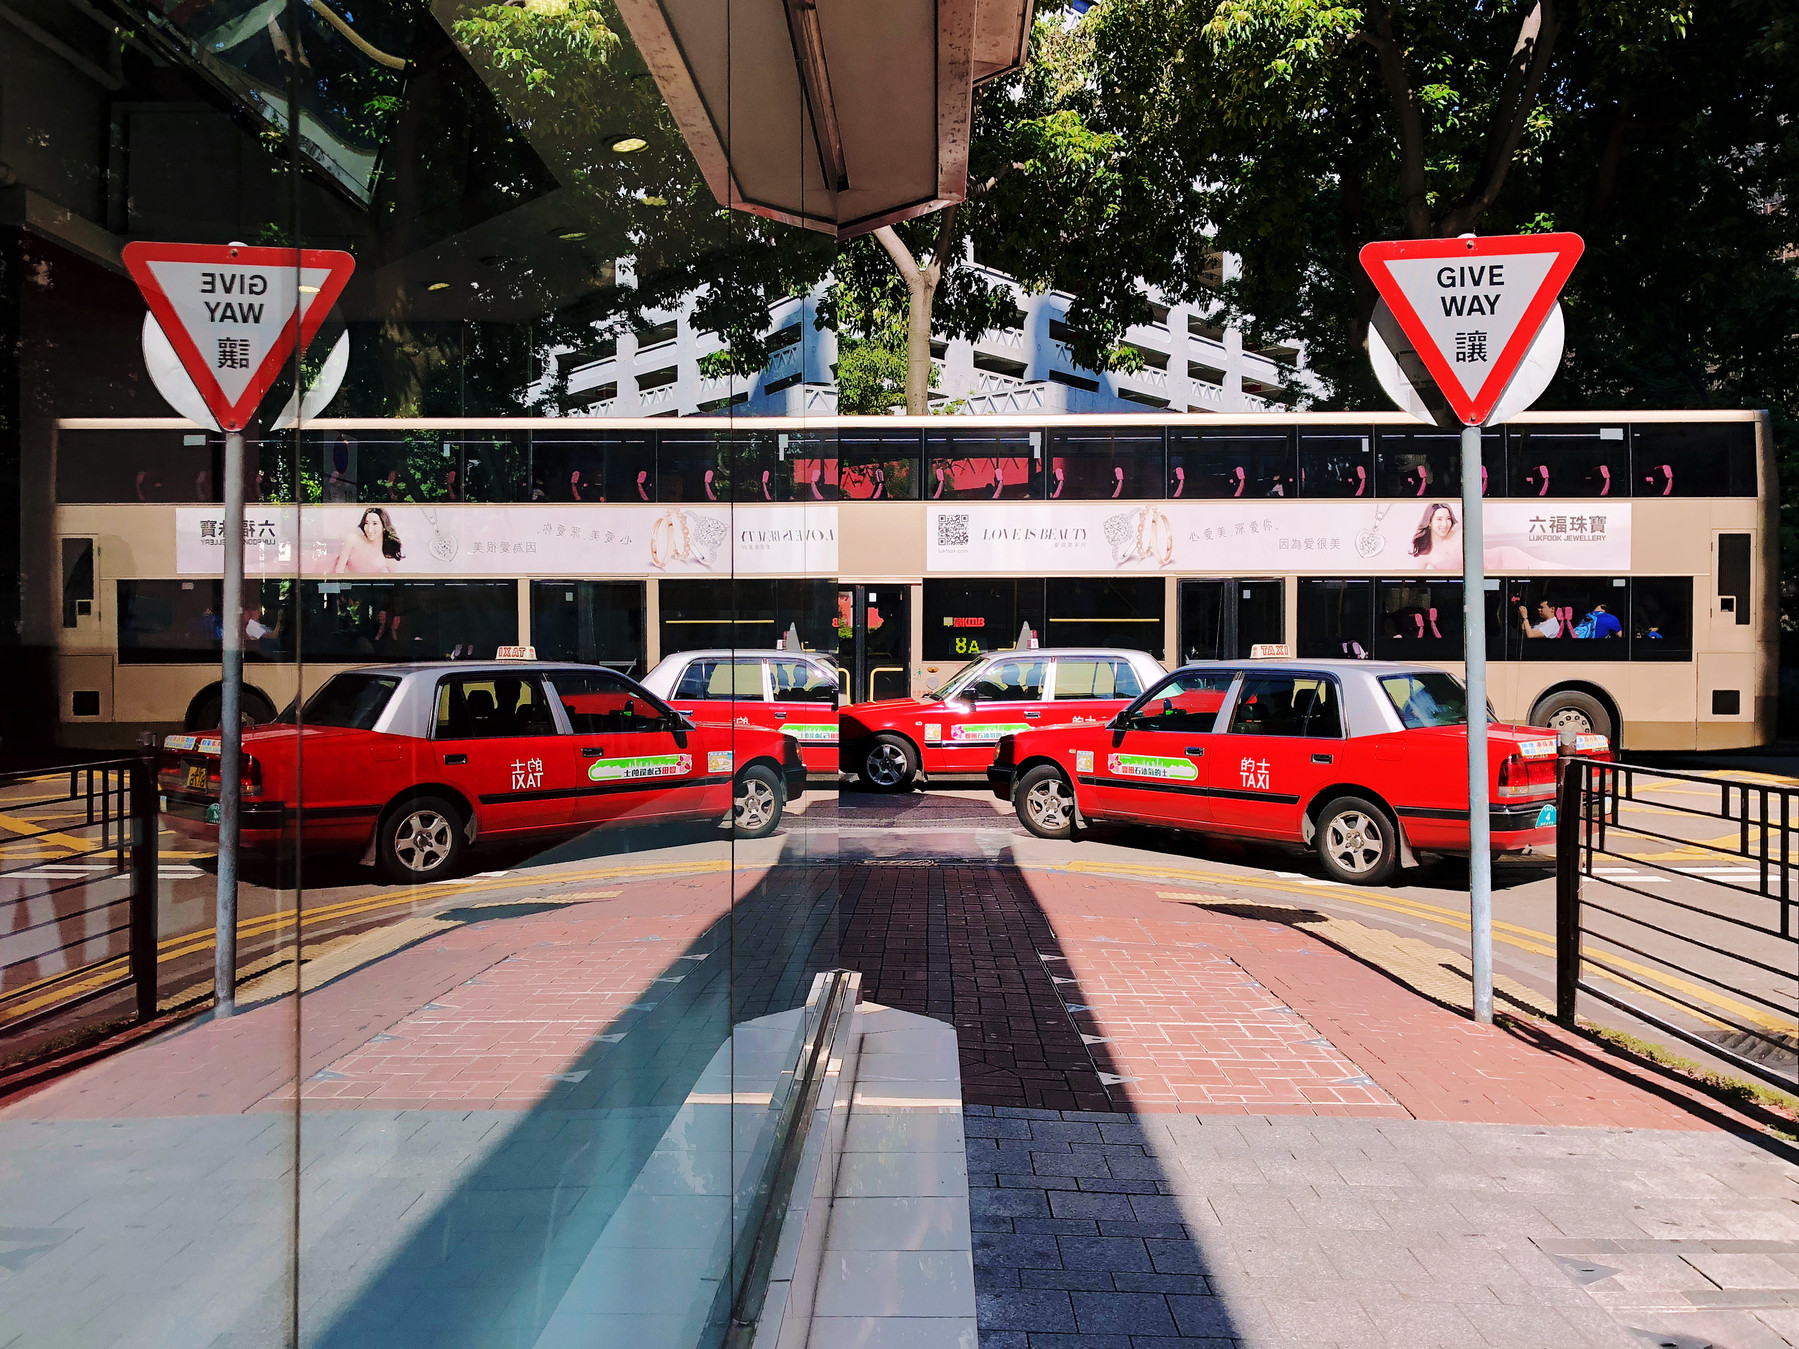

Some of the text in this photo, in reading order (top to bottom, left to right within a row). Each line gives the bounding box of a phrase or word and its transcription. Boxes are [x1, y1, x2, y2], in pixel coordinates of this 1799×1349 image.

[1436, 264, 1505, 288] GIVE
[1440, 294, 1501, 317] WAY
[1455, 330, 1488, 363] 讓
[1529, 515, 1607, 534] 六福珠寶
[983, 528, 1088, 541] LOVE IS BEAUTY
[1278, 538, 1341, 551] 因為愛很美
[955, 637, 980, 654] 8A
[1260, 645, 1289, 656] TAXI
[1240, 756, 1271, 773] 的士
[1239, 771, 1270, 790] TAXI
[1545, 811, 1551, 822] 4
